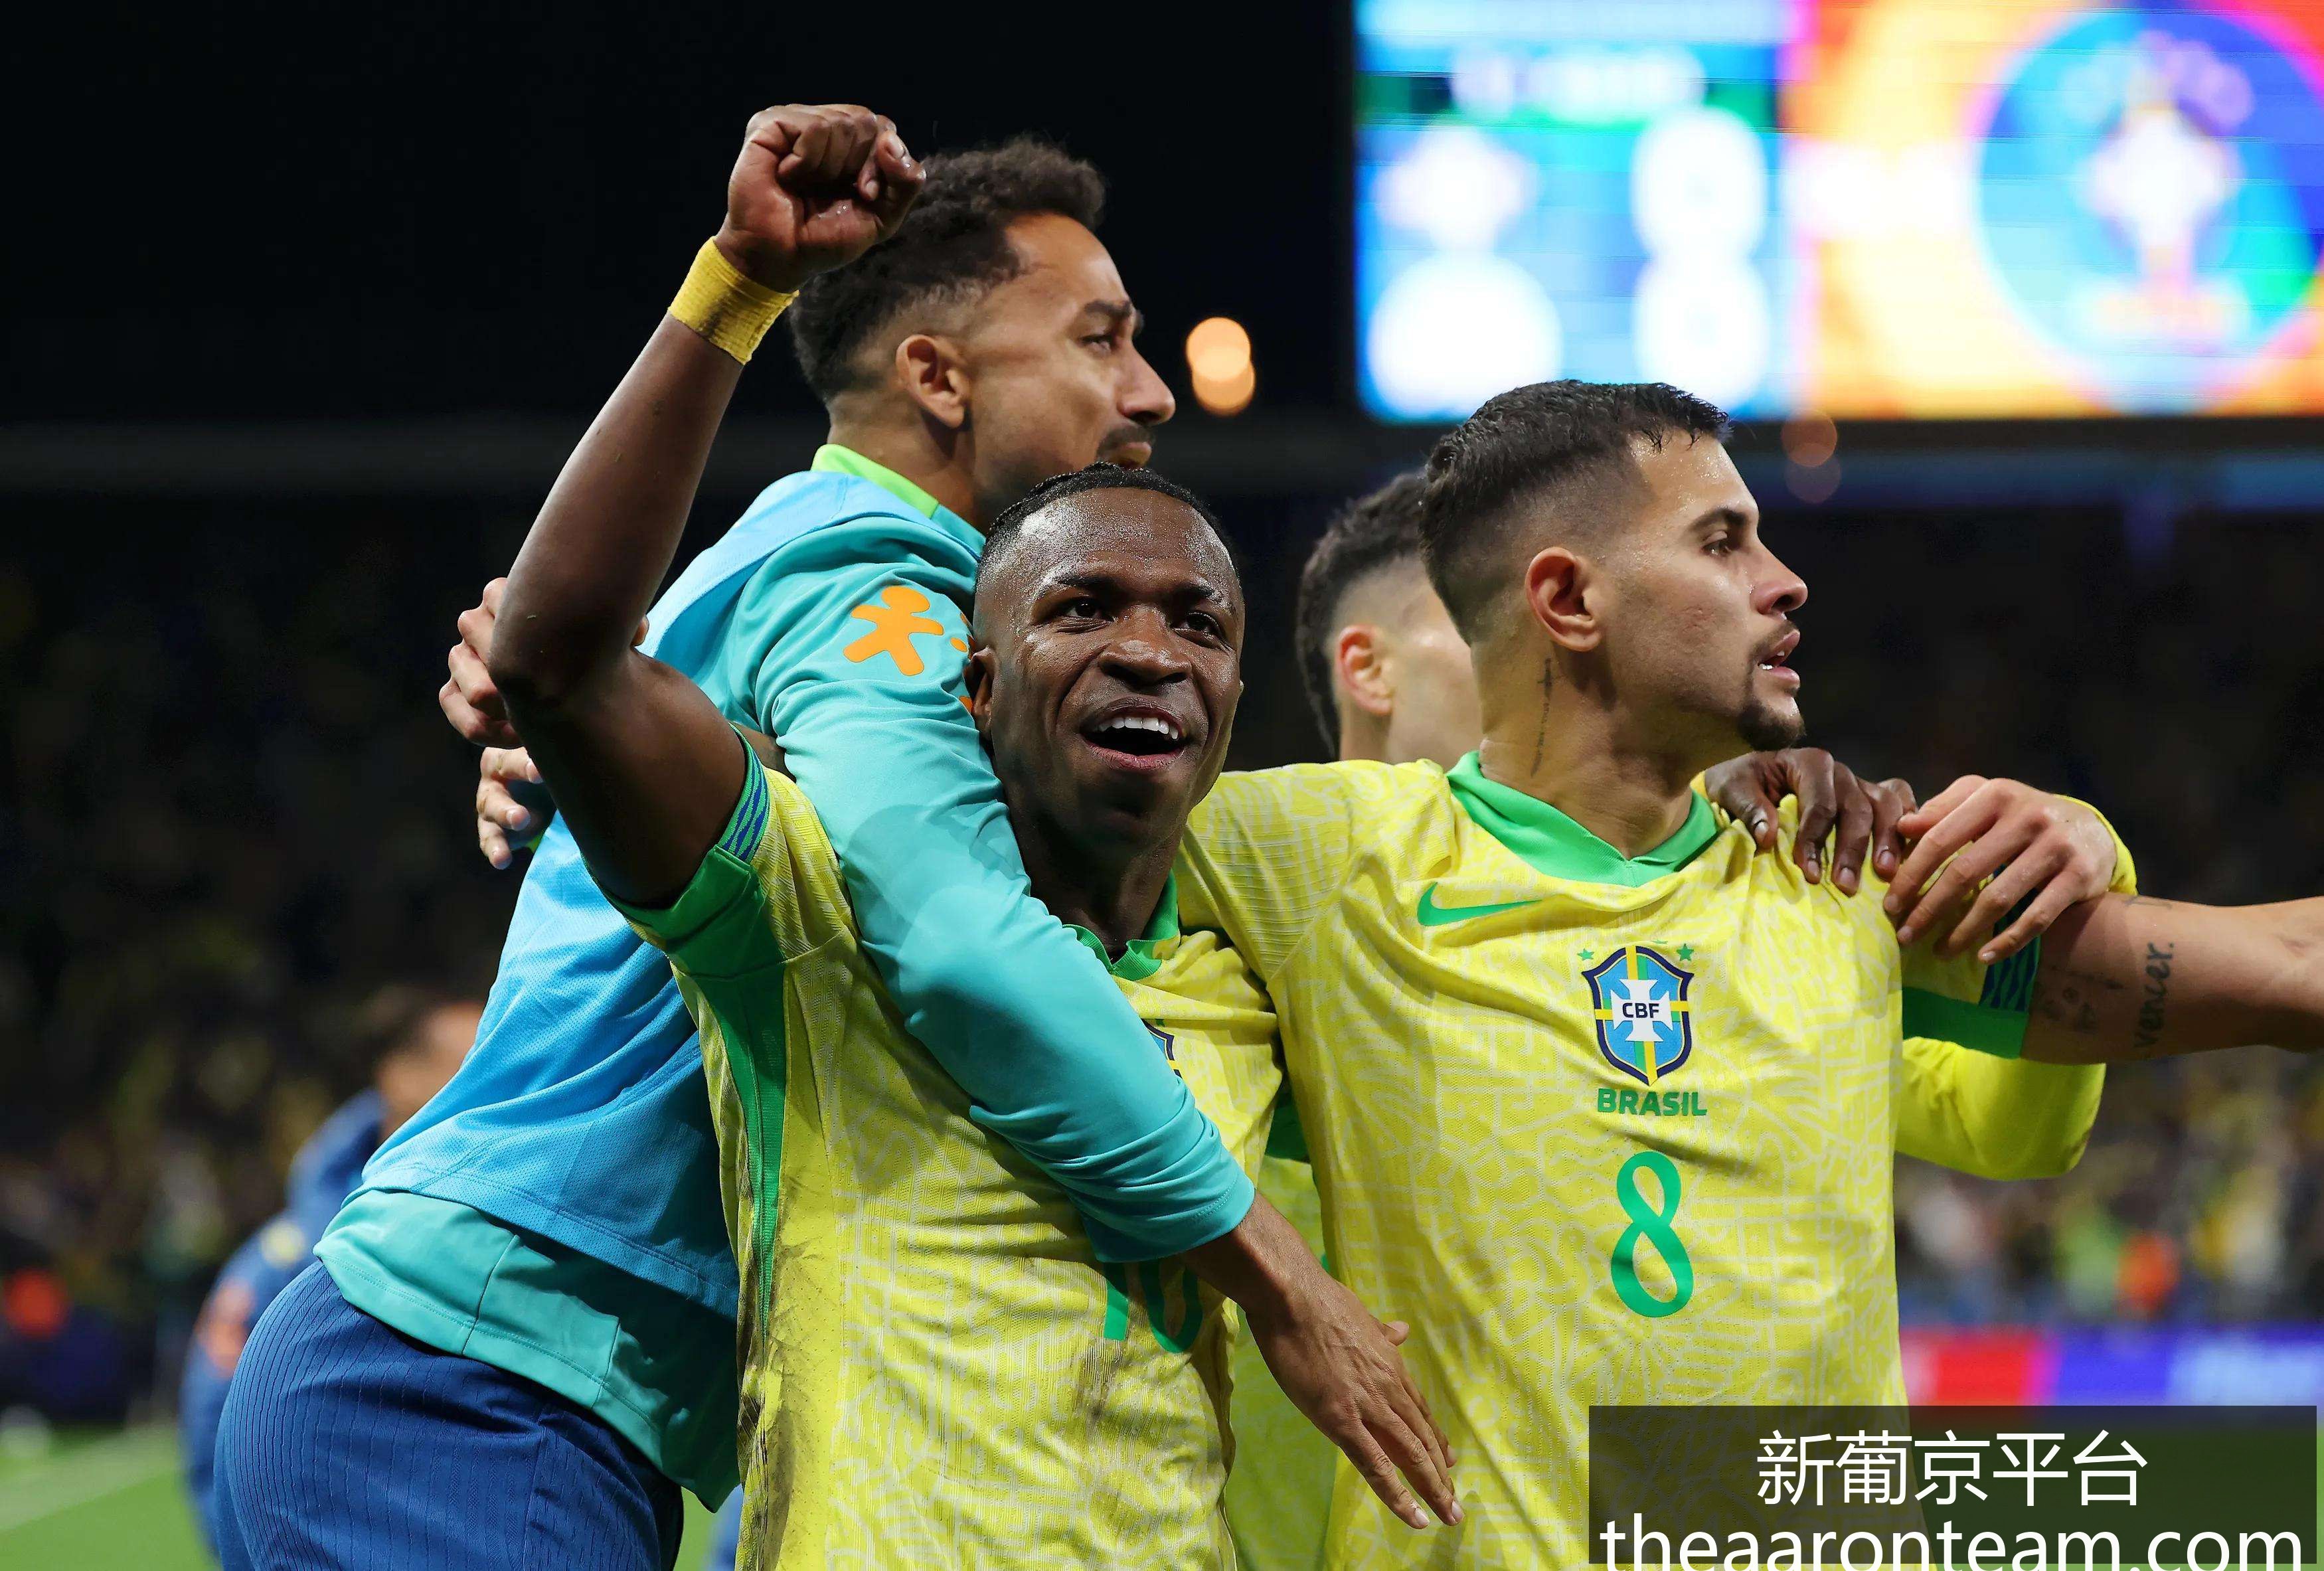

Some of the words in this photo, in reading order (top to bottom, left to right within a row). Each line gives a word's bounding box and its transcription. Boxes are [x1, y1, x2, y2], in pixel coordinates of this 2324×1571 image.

[1622, 1003, 1659, 1018] CBF
[1598, 1088, 1707, 1116] BRASIL
[1612, 1151, 1694, 1317] 8
